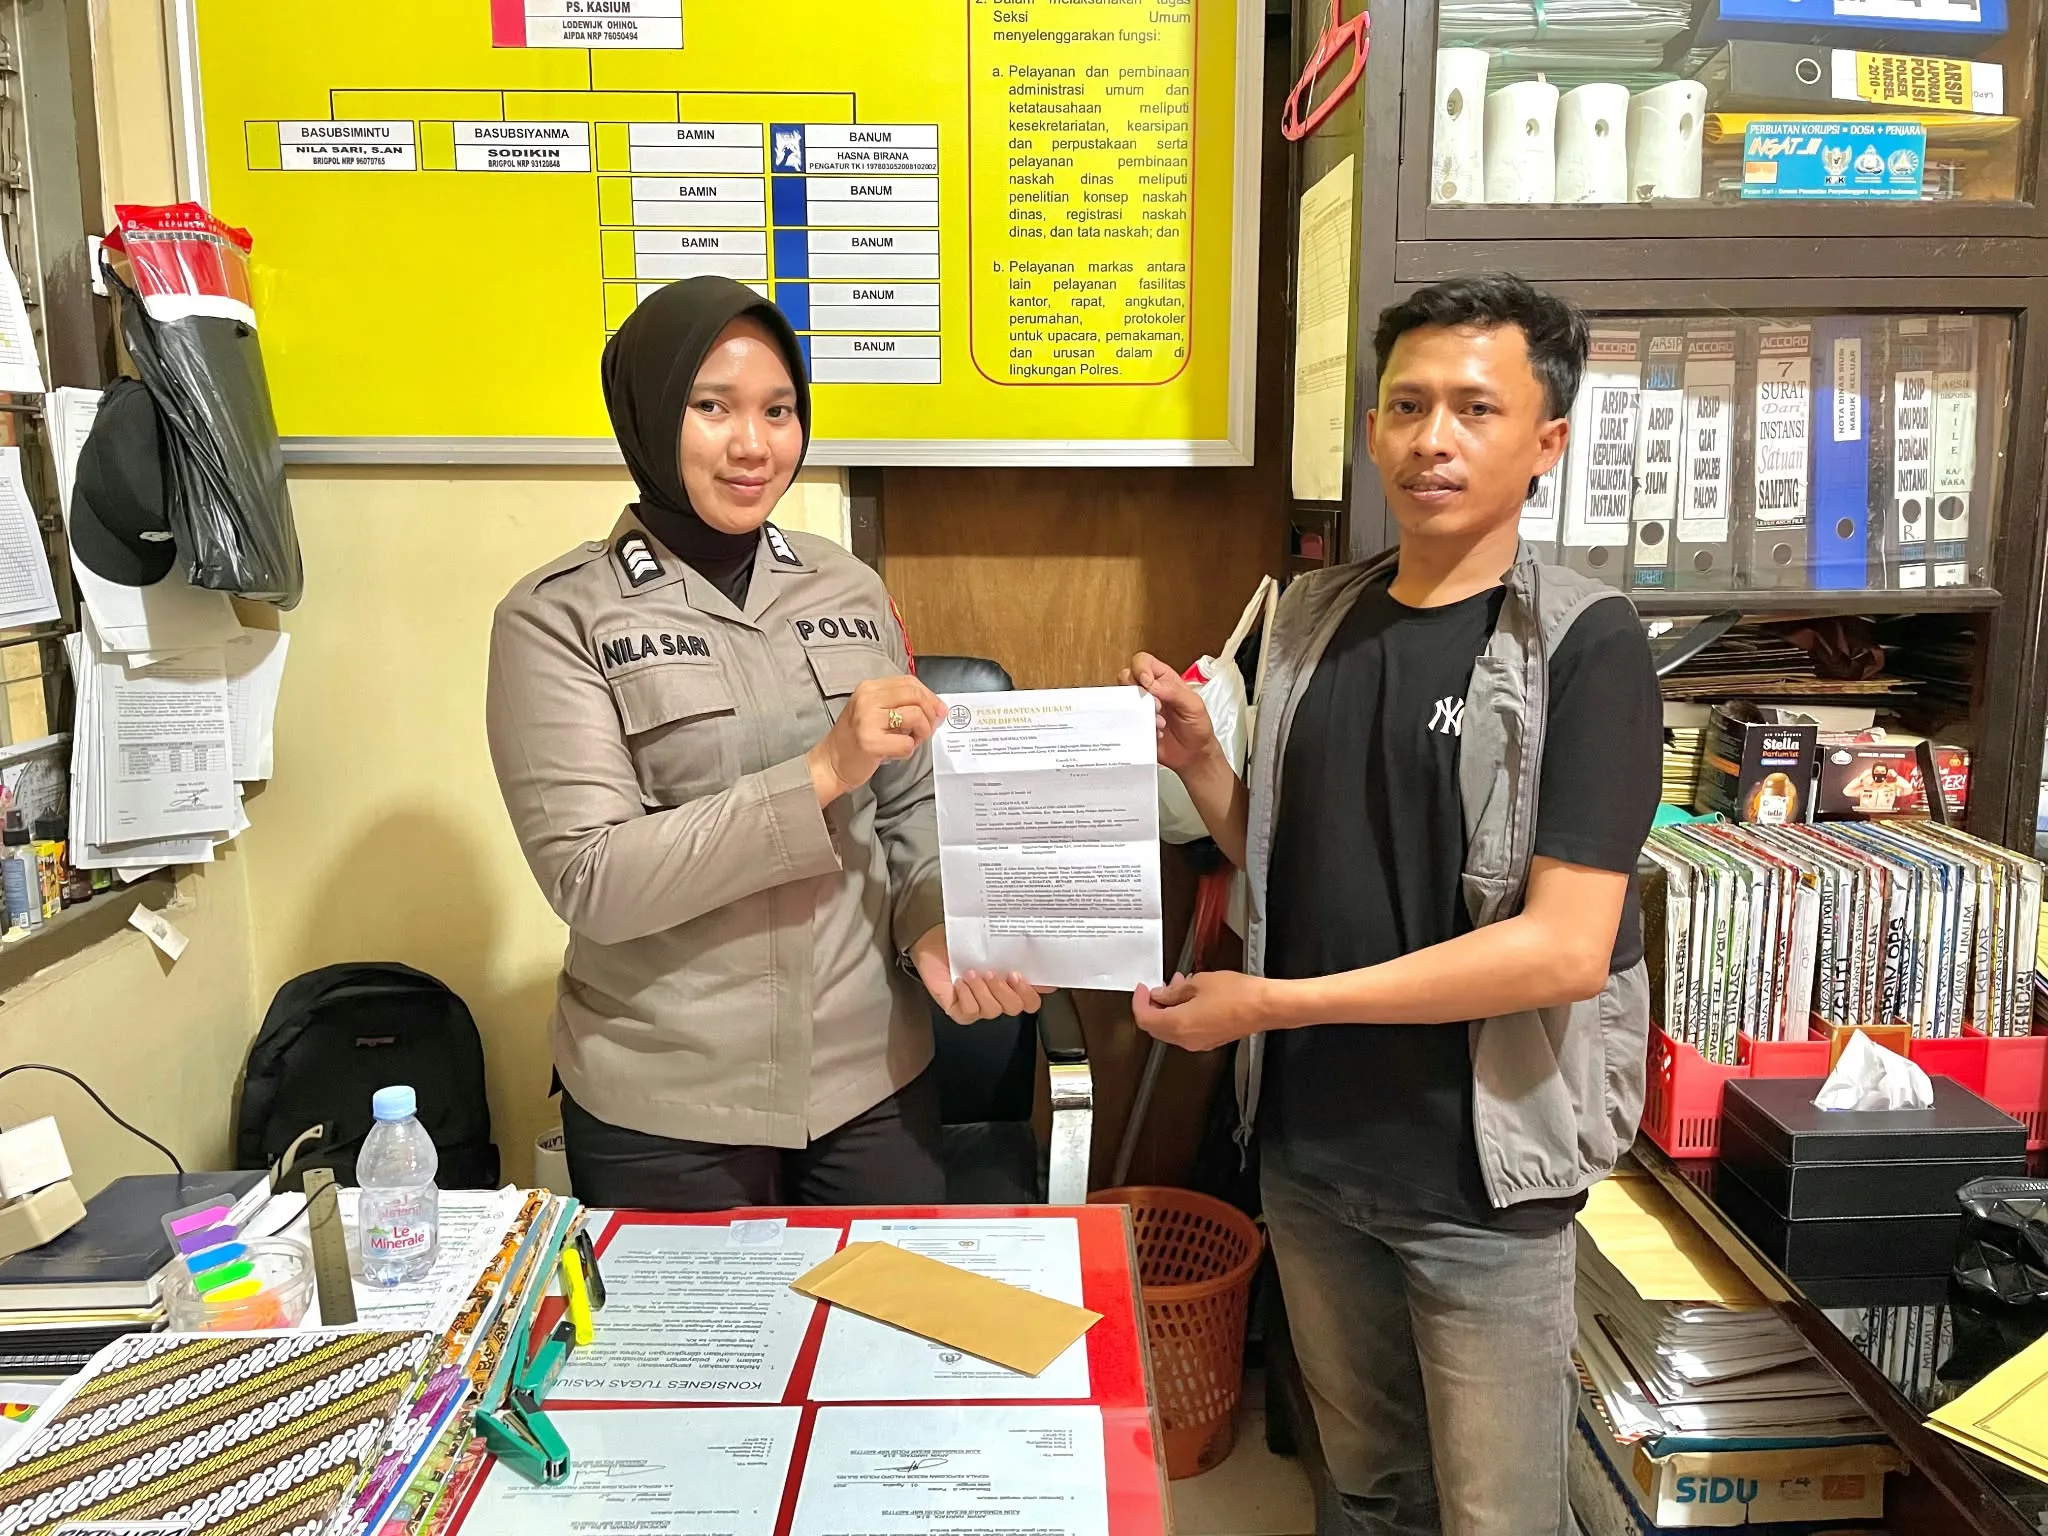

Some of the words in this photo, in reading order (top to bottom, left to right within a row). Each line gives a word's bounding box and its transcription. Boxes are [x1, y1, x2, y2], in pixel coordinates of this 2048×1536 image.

[567, 2, 584, 12] PS.
[587, 2, 630, 13] KASIUM
[994, 11, 1028, 22] Seksi
[1150, 12, 1190, 23] Umum
[563, 21, 602, 29] LODEWIJK
[608, 21, 637, 29] OHINOL
[564, 32, 585, 40] AIPDA
[587, 32, 602, 40] NRP
[604, 32, 638, 40] 76050494
[994, 30, 1114, 43] menyelenggarakan
[1119, 30, 1160, 43] fungsi:
[993, 67, 1003, 77] a.
[1010, 66, 1075, 80] Pelayanan
[1086, 67, 1108, 77] dan
[1119, 67, 1189, 81] pembinaan
[1883, 58, 1895, 99] WARSEL
[1896, 59, 1907, 97] POLSEK
[1911, 58, 1925, 102] POLISI
[1927, 59, 1940, 103] LAPORAN
[1944, 62, 1962, 105] ARSIP
[1009, 84, 1084, 95] administrasi
[1106, 87, 1144, 95] umum
[1166, 84, 1189, 95] dan
[1010, 102, 1101, 113] ketatausahaan
[1140, 103, 1188, 116] meliputi
[302, 128, 389, 138] BASUBSIMINTU
[475, 128, 568, 139] BASUBSIYANMA
[1010, 120, 1108, 133] kesekretariatan,
[1128, 121, 1188, 134] kearsipan
[1750, 125, 1799, 134] PERBUATAN
[1802, 125, 1840, 134] KORUPSI
[1850, 125, 1875, 134] DOSA
[1886, 125, 1921, 135] PENJARA
[677, 130, 714, 140] BAMIN
[849, 132, 891, 142] BANUM
[1009, 138, 1032, 149] dan
[1052, 139, 1136, 151] perpustakaan
[1157, 140, 1188, 149] serta
[488, 149, 559, 157] SODIKIN
[838, 152, 870, 160] HASNA
[874, 152, 908, 160] BIRANA
[313, 157, 340, 165] BRIGPOL
[342, 157, 354, 165] NRP
[489, 160, 515, 168] BRIGPOL
[1010, 156, 1073, 169] pelayanan
[1118, 156, 1188, 169] pembinaan
[1010, 174, 1054, 185] naskah
[1081, 174, 1113, 185] dinas
[1139, 174, 1188, 187] meliputi
[680, 187, 716, 196] BAMIN
[851, 186, 892, 195] BANUM
[1010, 192, 1069, 204] penelitian
[1084, 192, 1128, 205] konsep
[1143, 192, 1186, 203] naskah
[1010, 209, 1046, 222] dinas,
[1067, 209, 1122, 222] registrasi
[1143, 209, 1186, 220] naskah
[1010, 226, 1046, 239] dinas,
[1051, 227, 1073, 237] dan
[1078, 227, 1100, 237] tata
[1105, 227, 1152, 239] naskah;
[1157, 227, 1179, 237] dan
[682, 238, 718, 247] BAMIN
[852, 238, 892, 247] BANUM
[994, 262, 1004, 272] b.
[1010, 262, 1074, 275] Pelayanan
[1089, 262, 1133, 272] markas
[1147, 263, 1185, 272] antara
[1010, 279, 1031, 289] lain
[1054, 279, 1116, 292] pelayanan
[1139, 279, 1185, 290] fasilitas
[853, 290, 894, 299] BANUM
[1010, 296, 1051, 308] kantor,
[1072, 298, 1105, 309] rapat,
[1125, 297, 1185, 309] angkutan,
[1010, 314, 1083, 327] perumahan,
[1124, 314, 1185, 327] protokoler
[1010, 330, 1042, 341] untuk
[1048, 333, 1101, 344] upacara,
[1106, 331, 1184, 344] pemakaman,
[1760, 336, 1808, 348] ACCORD
[854, 342, 894, 351] BANUM
[1010, 348, 1032, 358] dan
[1054, 350, 1094, 358] urusan
[1116, 348, 1152, 358] dalam
[1175, 348, 1184, 358] di
[1688, 342, 1734, 352] ACCORD
[1010, 365, 1076, 378] lingkungan
[1081, 365, 1122, 376] Polres.
[1778, 361, 1793, 377] 7
[1762, 381, 1807, 400] SURAT
[1903, 378, 1924, 400] ARSIP
[1602, 391, 1628, 413] ARSIP
[1697, 396, 1720, 418] ARSIP
[1762, 402, 1801, 414] Dari
[1648, 408, 1673, 430] ARSIP
[1600, 418, 1628, 440] SURAT
[1760, 420, 1805, 439] INSTANSI
[1699, 429, 1716, 451] GIAT
[1593, 443, 1633, 465] KEPUTUSAN
[1647, 440, 1671, 463] LAPBUL
[1898, 439, 1928, 461] DENGAN
[1759, 445, 1803, 473] Satuan
[1694, 458, 1720, 480] KAPOLRES
[1590, 469, 1627, 490] WALIKOTA
[1645, 472, 1667, 494] SIUM
[1898, 469, 1927, 491] INSTANSI
[1694, 487, 1717, 509] PALOPO
[1759, 479, 1799, 509] SAMPING
[1591, 495, 1626, 517] INSTANSI
[797, 618, 879, 642] POLRI
[602, 637, 658, 669] NILA
[663, 634, 710, 657] SARI
[1428, 696, 1465, 736] NY
[1763, 739, 1799, 750] Stella
[393, 1227, 409, 1238] Le
[371, 1232, 424, 1249] Minerale
[609, 1380, 661, 1388] TUGAS
[668, 1381, 762, 1389] KONSIGNES
[1676, 1477, 1758, 1503] SiDU
